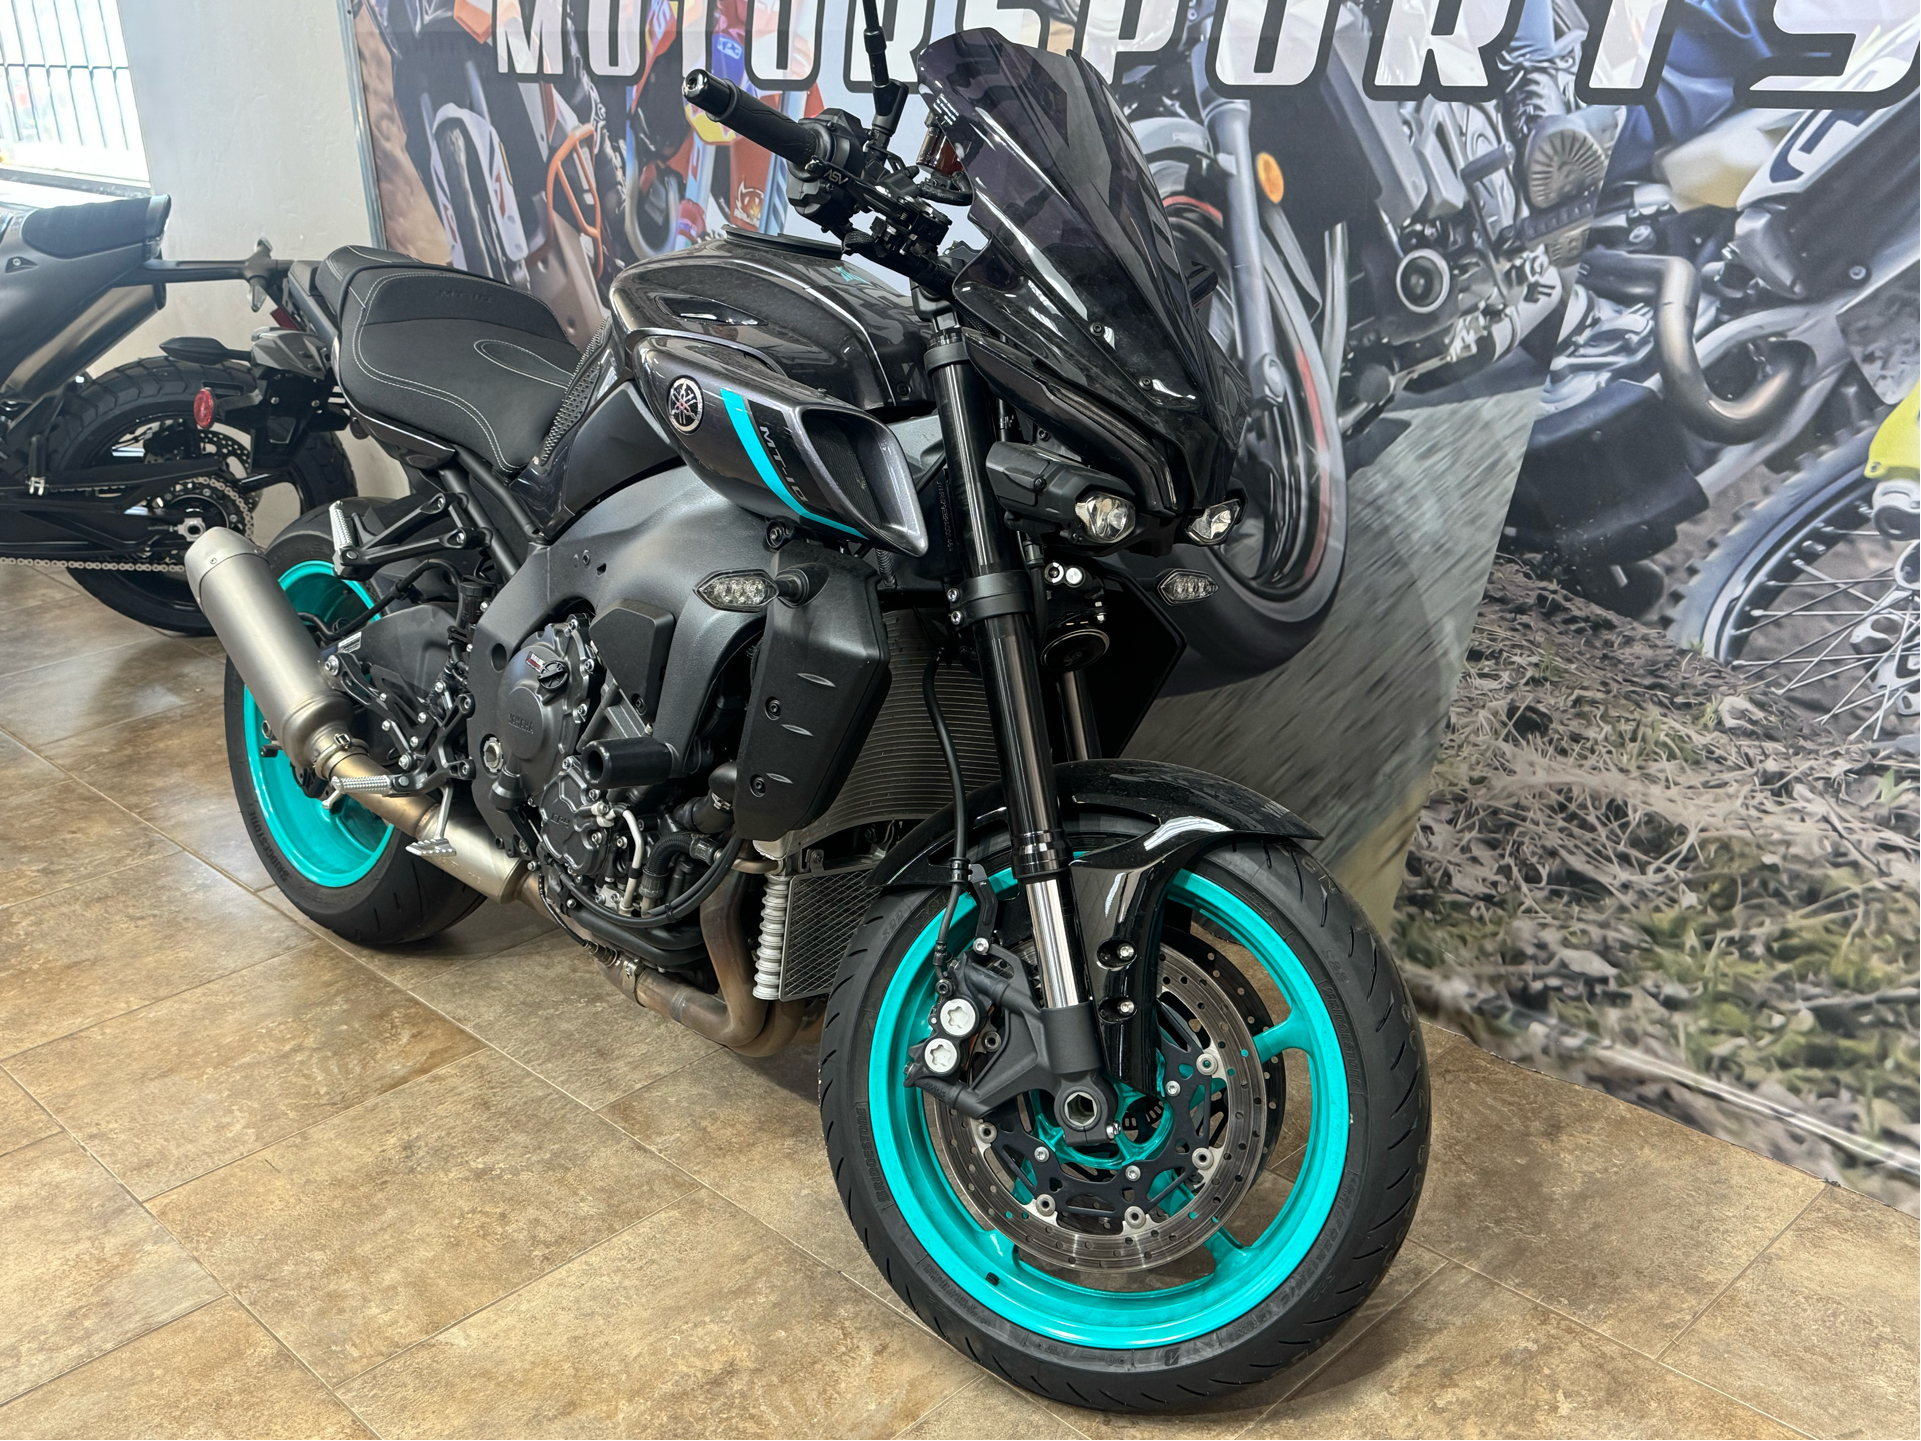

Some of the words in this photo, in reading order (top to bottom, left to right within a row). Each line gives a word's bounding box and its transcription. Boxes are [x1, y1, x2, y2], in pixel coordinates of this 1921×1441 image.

[823, 169, 849, 185] ASV
[759, 426, 809, 502] MT-10
[855, 1106, 891, 1203] BRIDGESTONE
